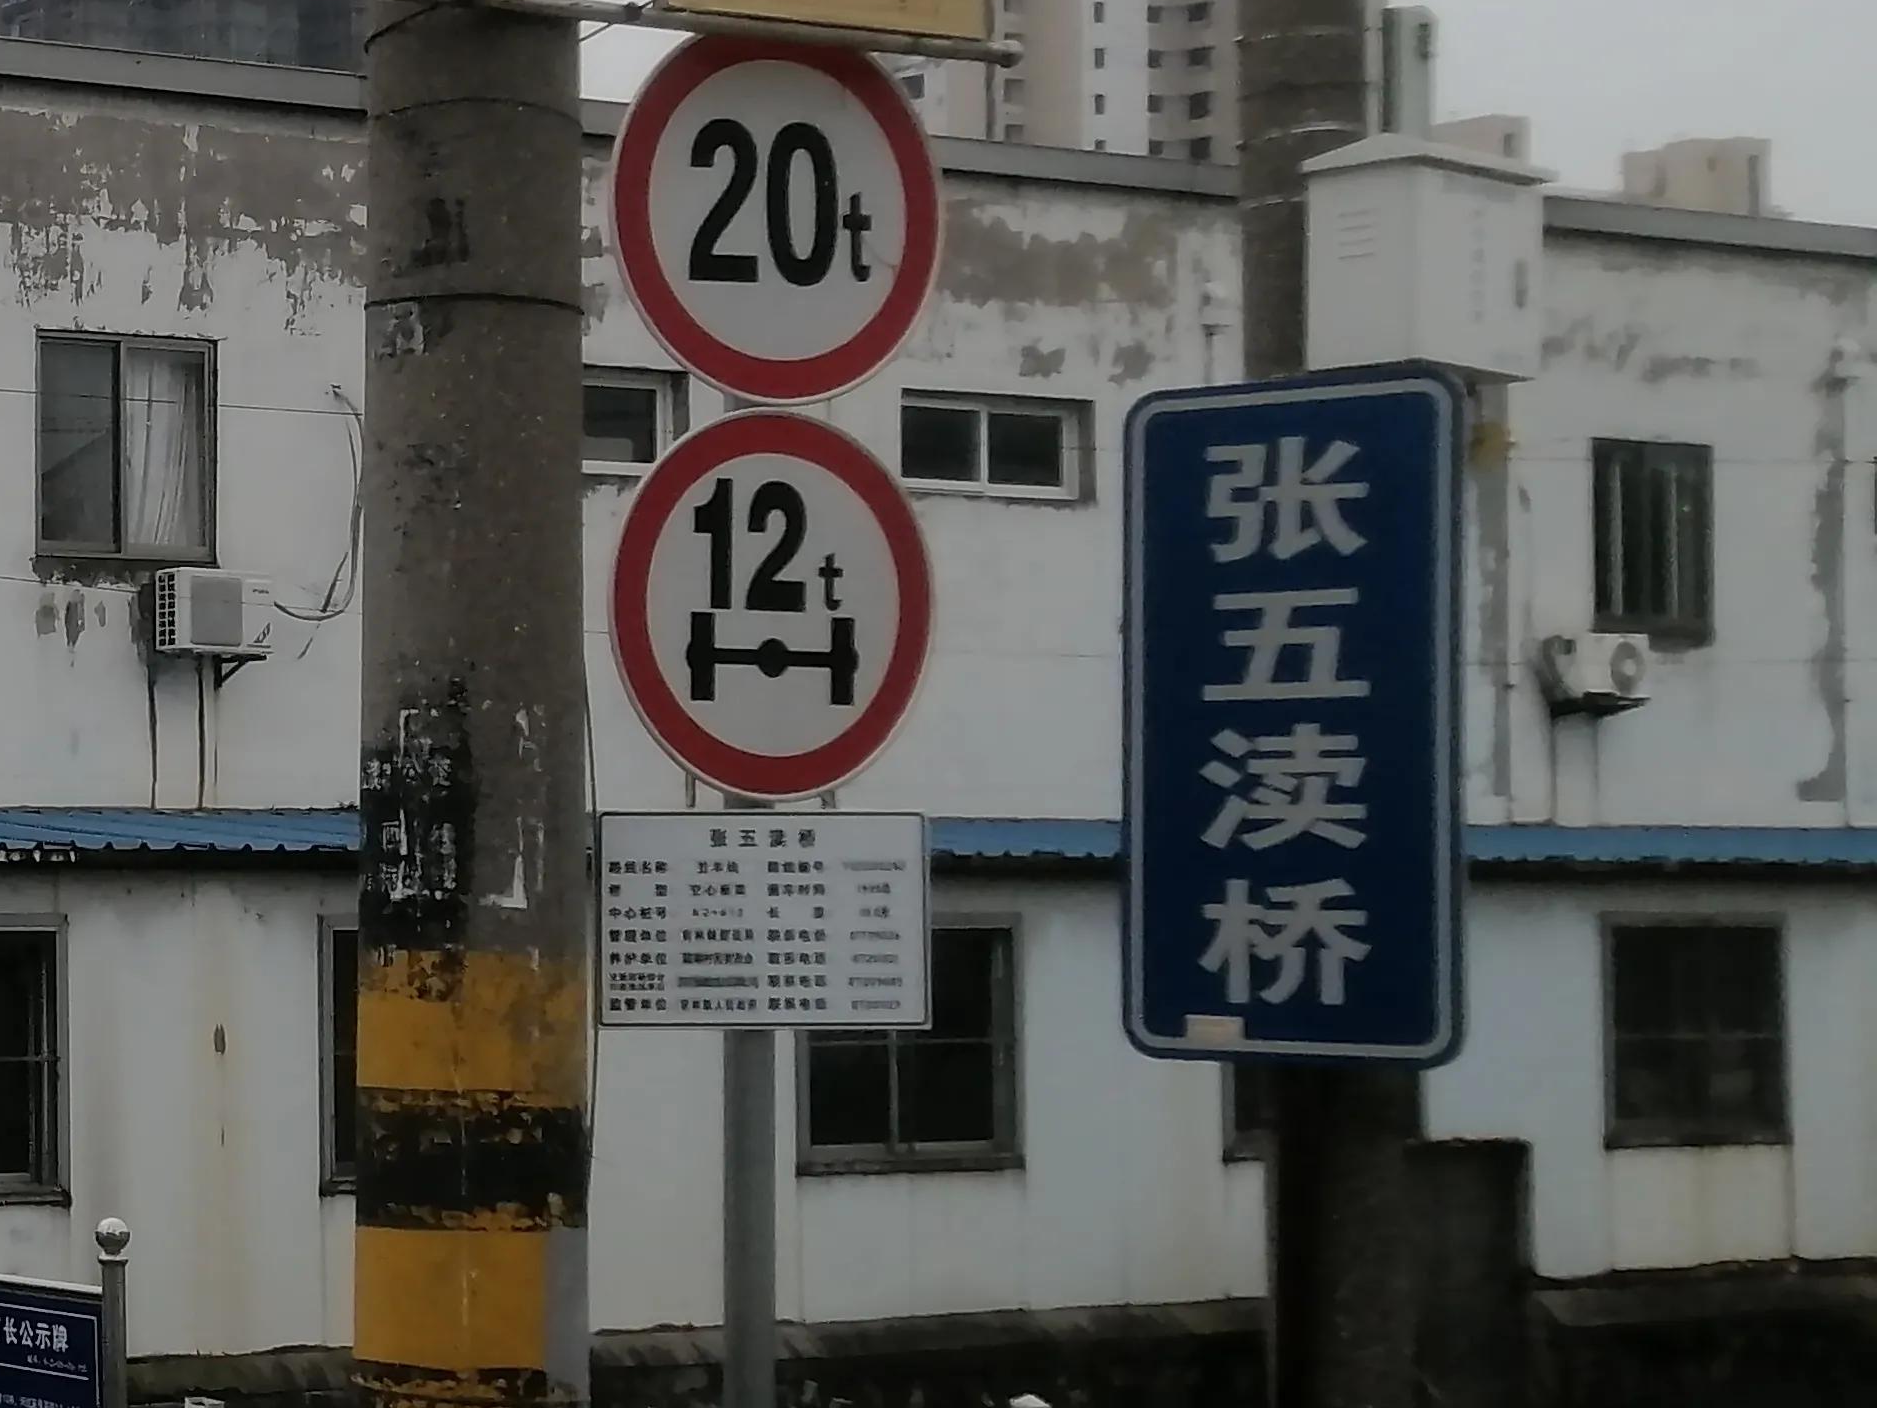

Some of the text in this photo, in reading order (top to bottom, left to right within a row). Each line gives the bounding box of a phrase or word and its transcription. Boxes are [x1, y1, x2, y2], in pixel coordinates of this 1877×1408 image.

[688, 118, 872, 287] 20t
[692, 476, 843, 613] 12t
[1200, 435, 1372, 1007] 张五渎桥
